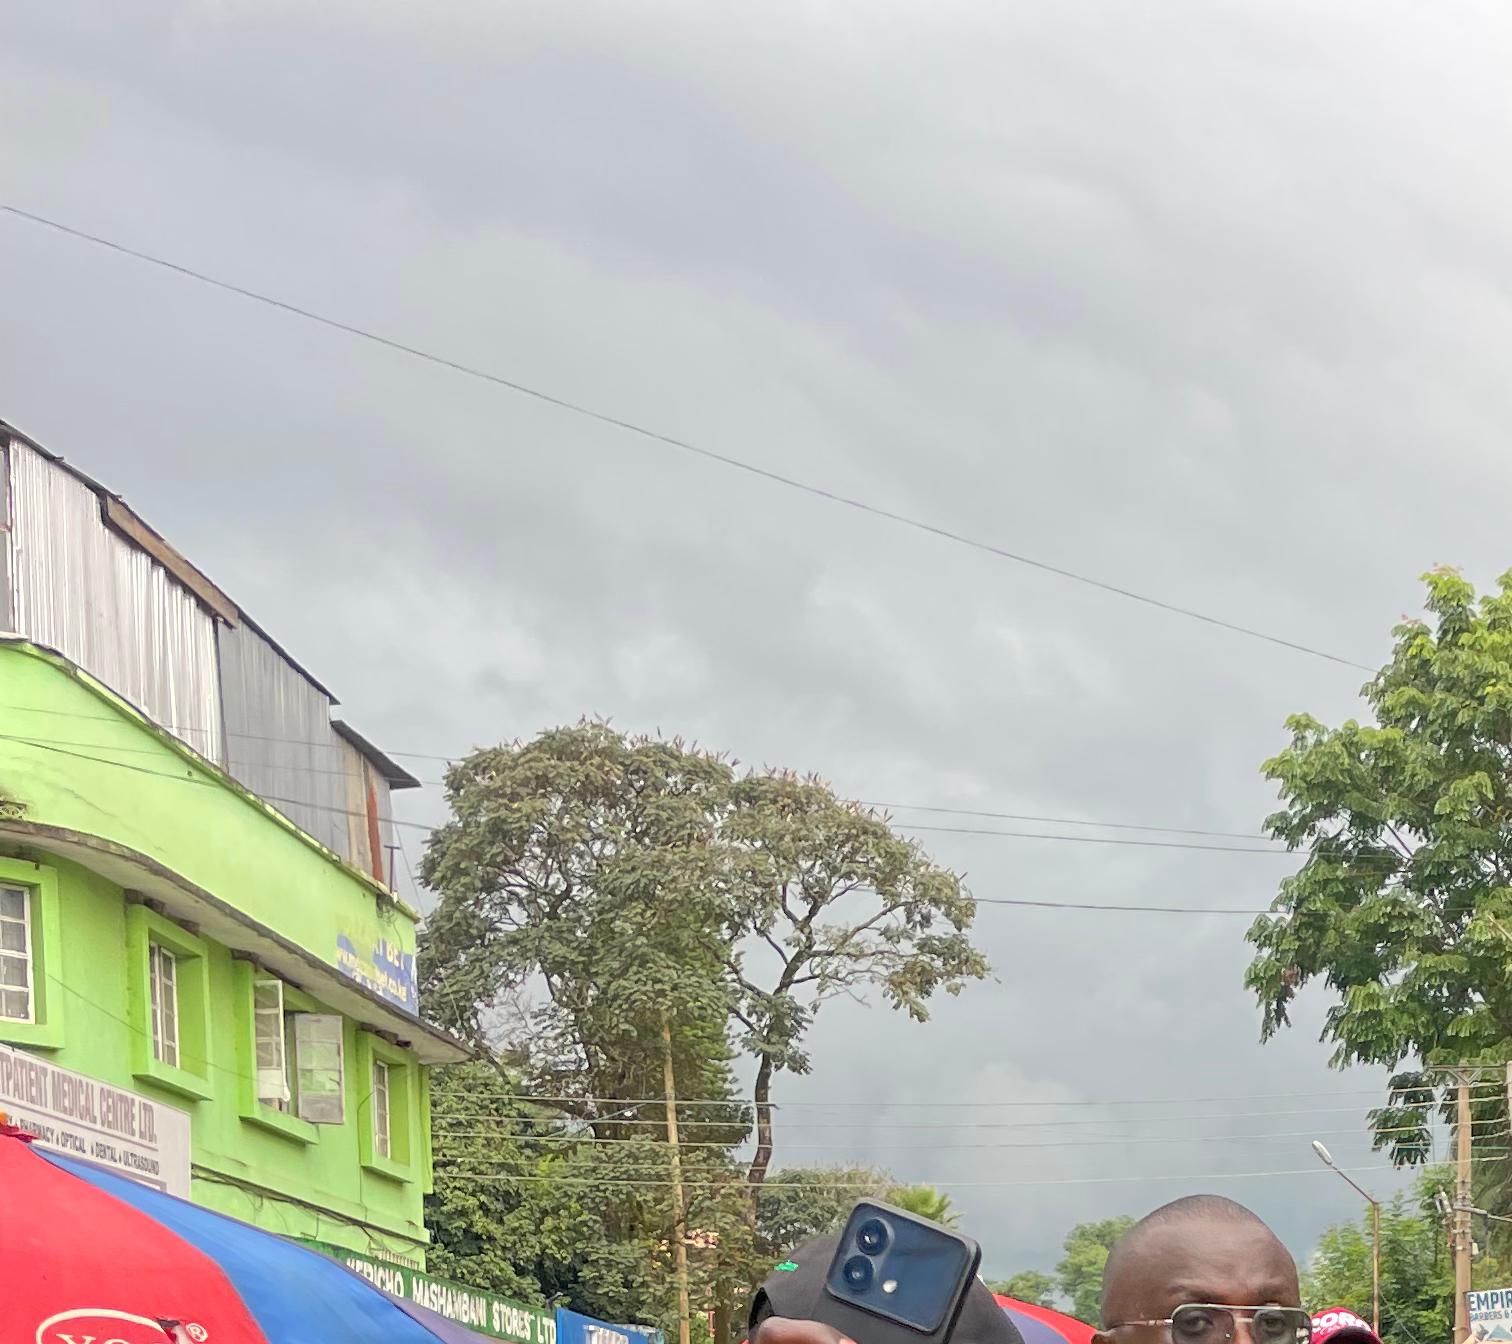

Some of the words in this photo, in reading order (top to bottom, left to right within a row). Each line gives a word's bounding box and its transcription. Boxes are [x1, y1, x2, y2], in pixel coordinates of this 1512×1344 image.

[51, 1070, 97, 1125] MEDICAL
[99, 1087, 136, 1137] CENTRE
[61, 1130, 87, 1154] OPTICAL
[95, 1142, 118, 1163] DENTAL
[122, 1150, 160, 1176] ULTRASOUND
[412, 1276, 487, 1328] MASHAMBANI
[492, 1299, 532, 1339] STORES
[1470, 1311, 1503, 1321] BARBERS
